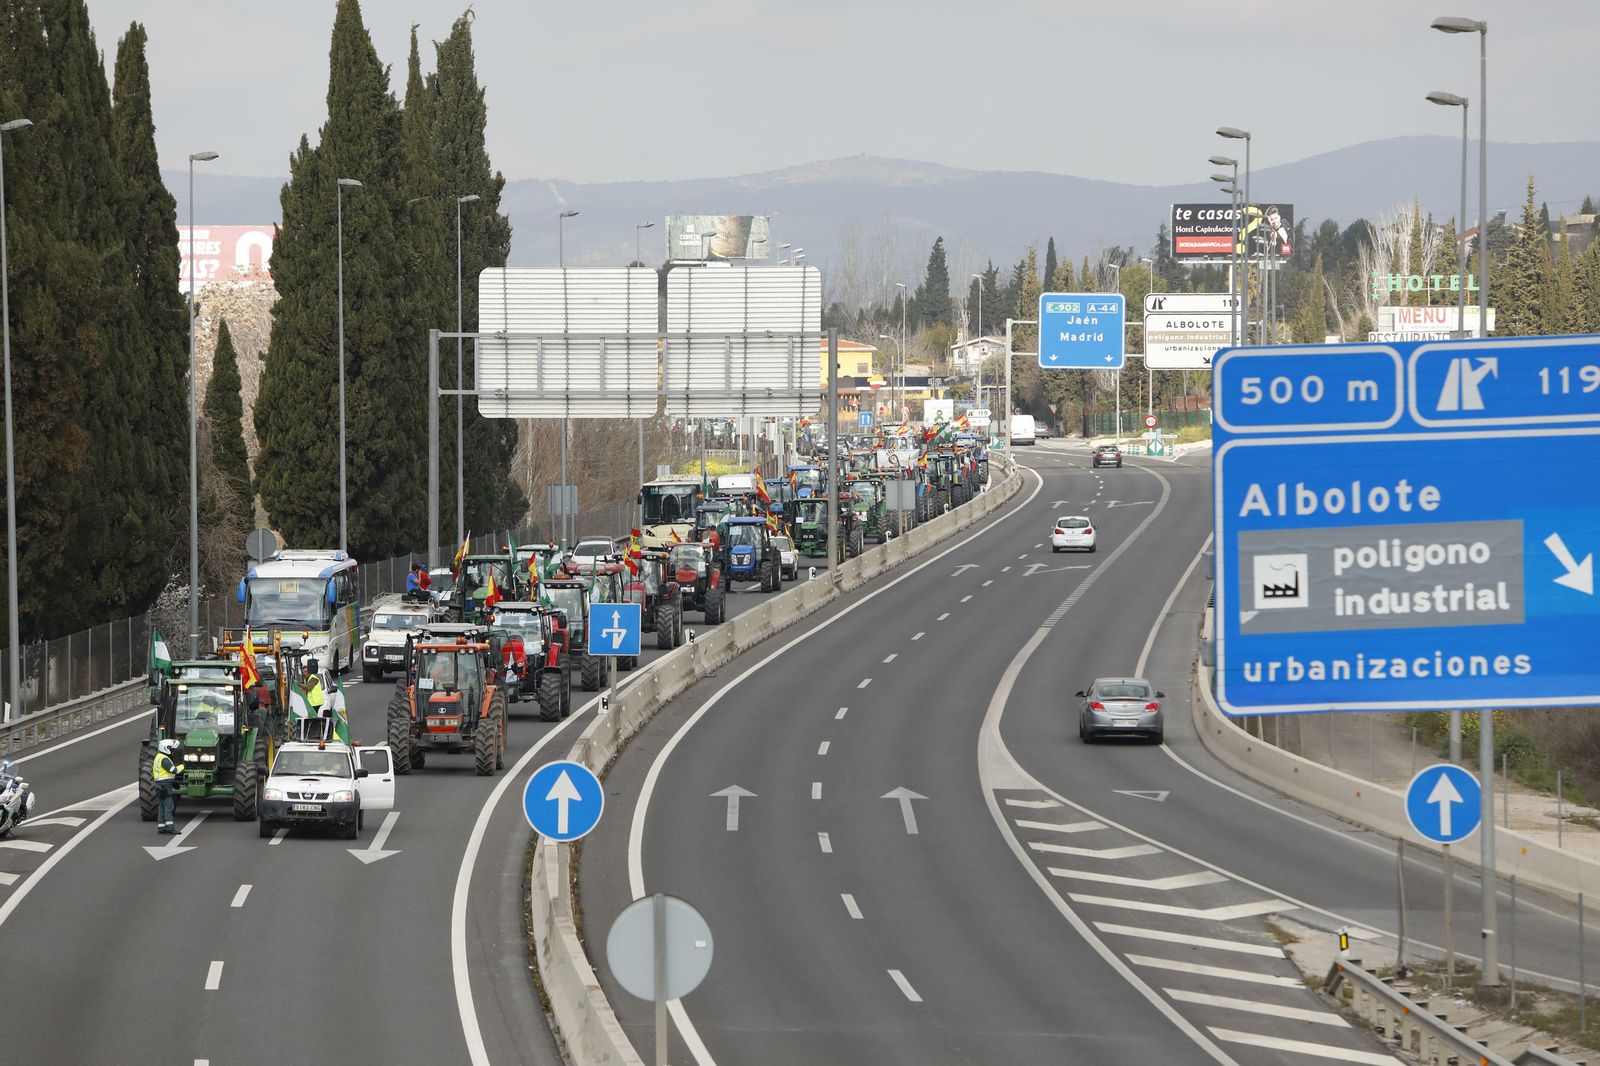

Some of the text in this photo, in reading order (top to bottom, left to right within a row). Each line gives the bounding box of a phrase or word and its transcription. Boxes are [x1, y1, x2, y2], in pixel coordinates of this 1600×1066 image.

[1175, 207, 1193, 220] te
[1175, 225, 1194, 233] Hotel
[1386, 273, 1480, 292] HOTEL
[1089, 303, 1117, 312] A-44
[1066, 315, 1098, 325] Jaén
[1398, 308, 1447, 324] MENU
[1166, 320, 1225, 329] ALBOLOTE
[1060, 331, 1104, 342] Madrid
[1538, 365, 1600, 395] 119
[1240, 375, 1380, 406] 500 m
[1238, 479, 1442, 518] Albolote
[1334, 582, 1511, 617] industrial
[1243, 650, 1533, 683] urbanizaciones
